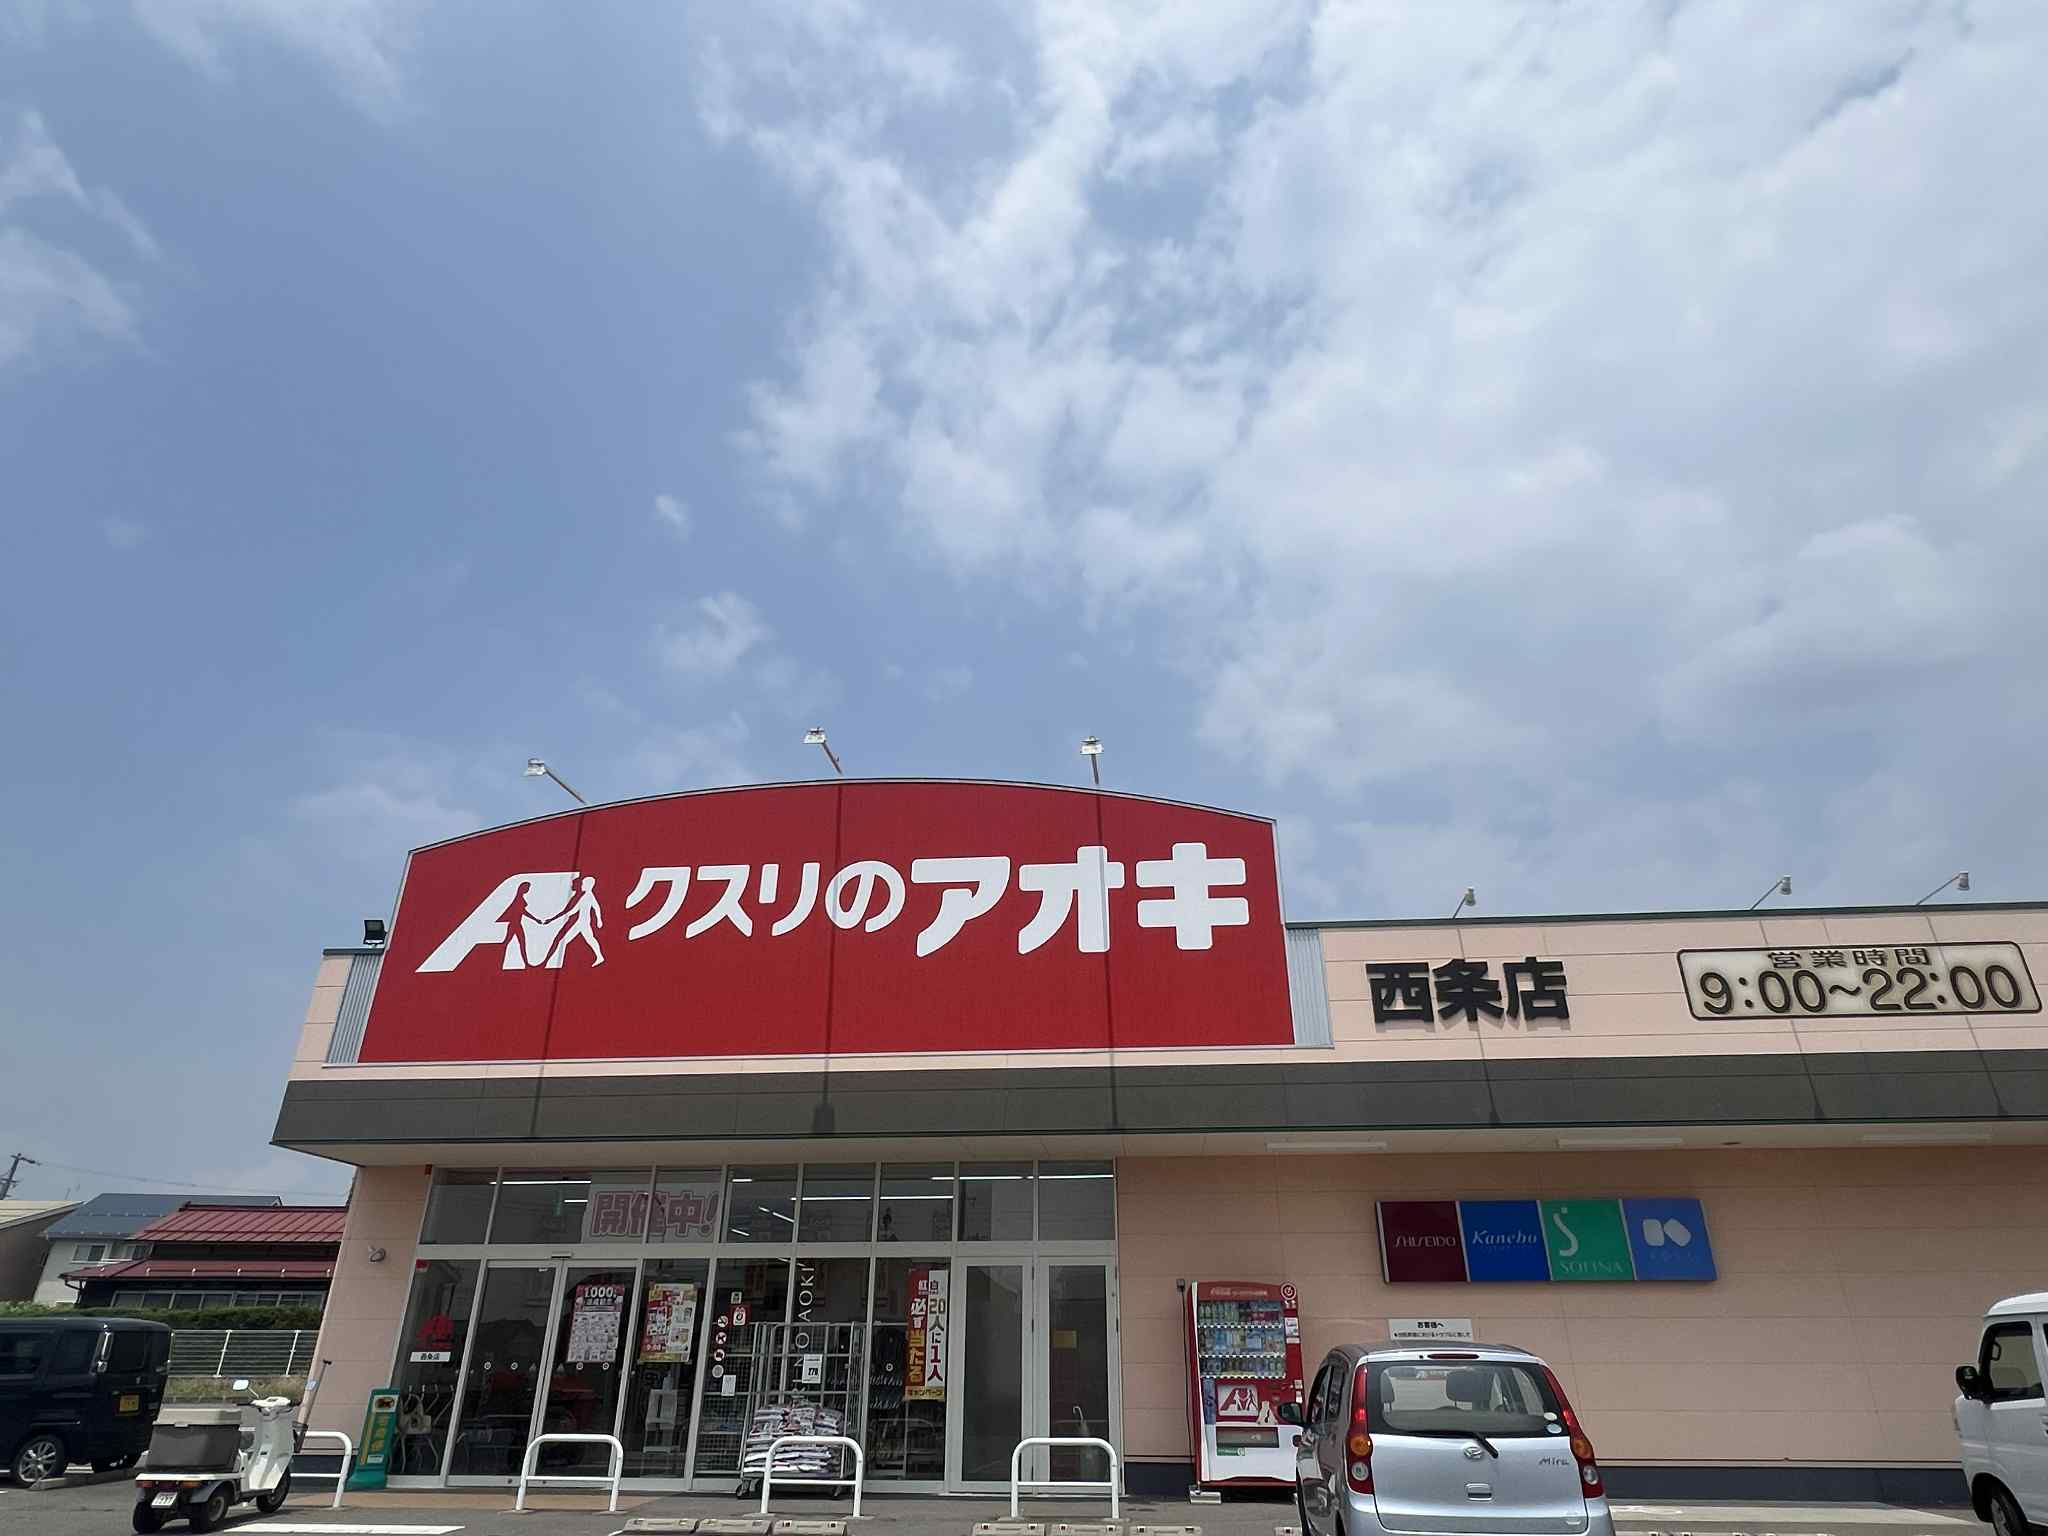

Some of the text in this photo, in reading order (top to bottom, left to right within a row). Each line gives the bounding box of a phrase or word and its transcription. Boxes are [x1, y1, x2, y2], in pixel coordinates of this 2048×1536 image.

[625, 842, 1249, 958] クスリのアオキ
[1767, 947, 1932, 969] 営業時間
[1365, 956, 1570, 1023] 西条店
[1393, 1235, 1457, 1248] SHISEIDO
[1472, 1229, 1538, 1245] Kanebo
[798, 1266, 815, 1322] AOKI
